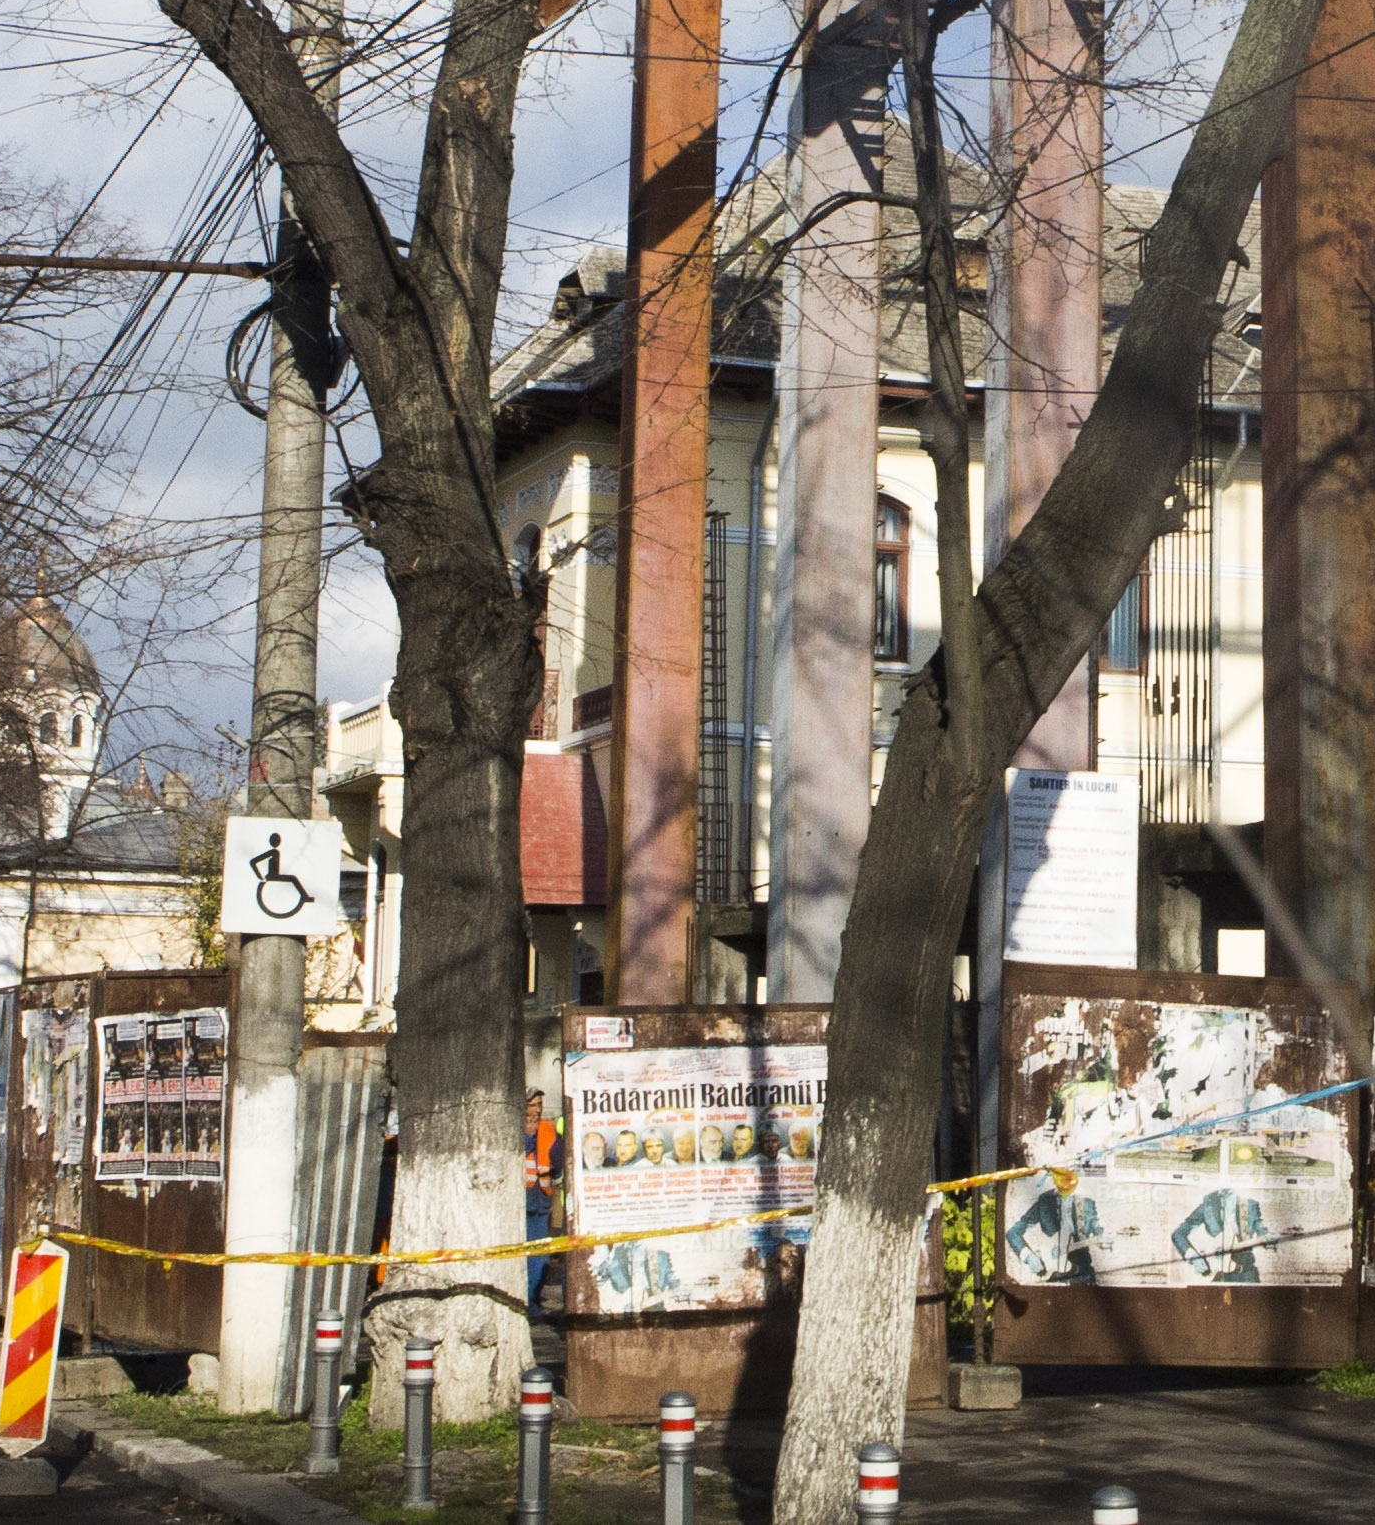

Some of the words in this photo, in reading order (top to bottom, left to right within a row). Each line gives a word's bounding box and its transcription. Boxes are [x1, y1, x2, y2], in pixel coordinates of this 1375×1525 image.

[1086, 780, 1118, 793] LUCRU
[582, 1083, 695, 1114] Bădăranii
[700, 1078, 811, 1109] Bădăranii
